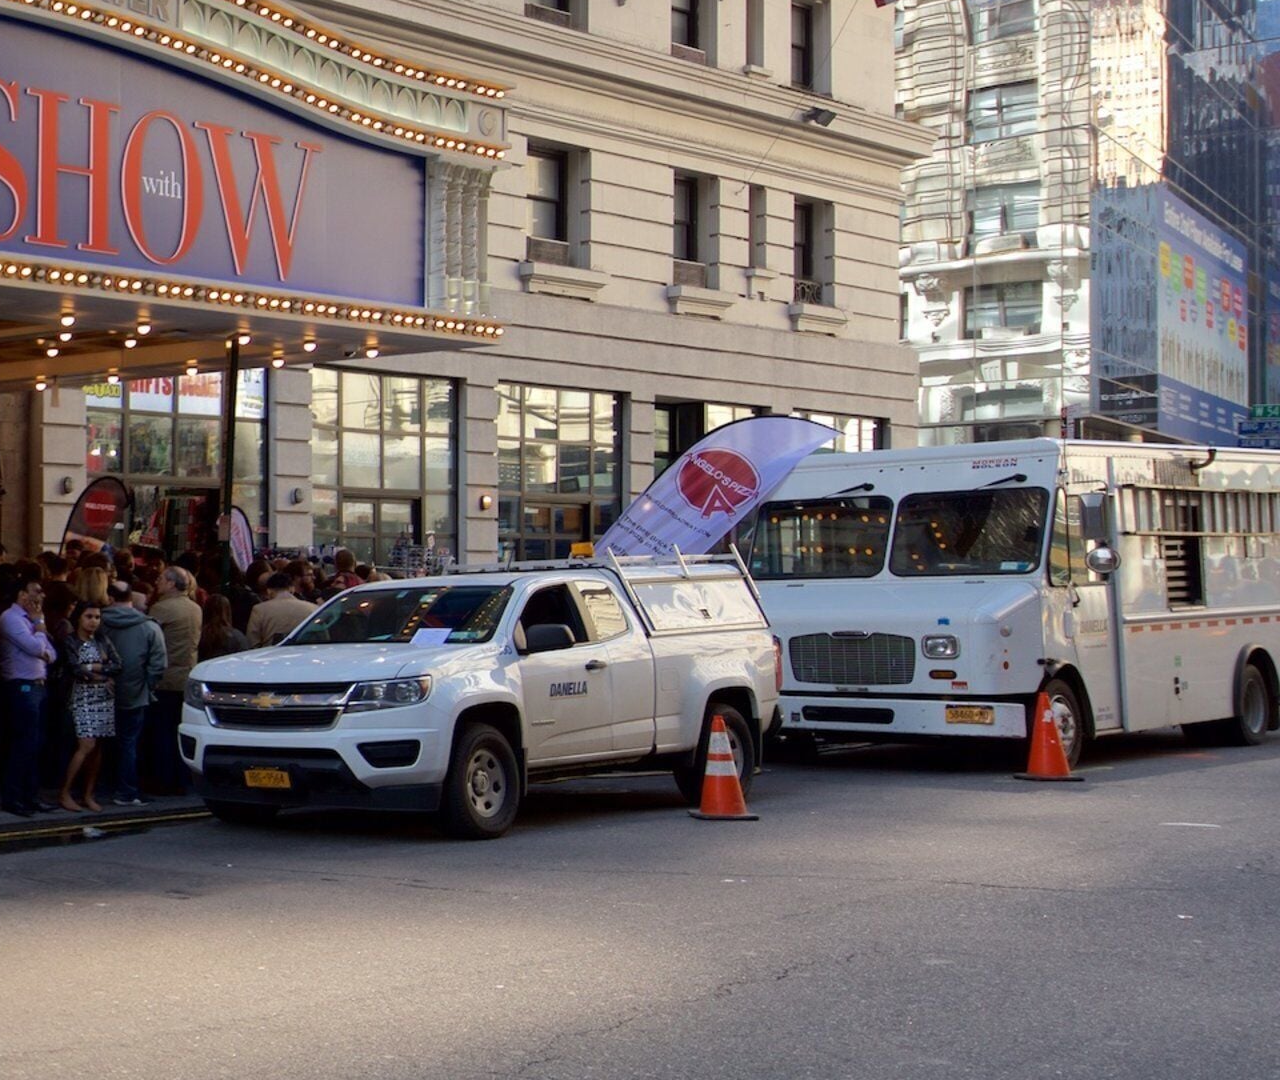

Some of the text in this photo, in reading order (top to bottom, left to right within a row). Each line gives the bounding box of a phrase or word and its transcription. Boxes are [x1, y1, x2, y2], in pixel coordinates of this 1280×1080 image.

[141, 167, 182, 200] with
[688, 453, 732, 486] ANGELO'S
[549, 680, 588, 697] DANELLA
